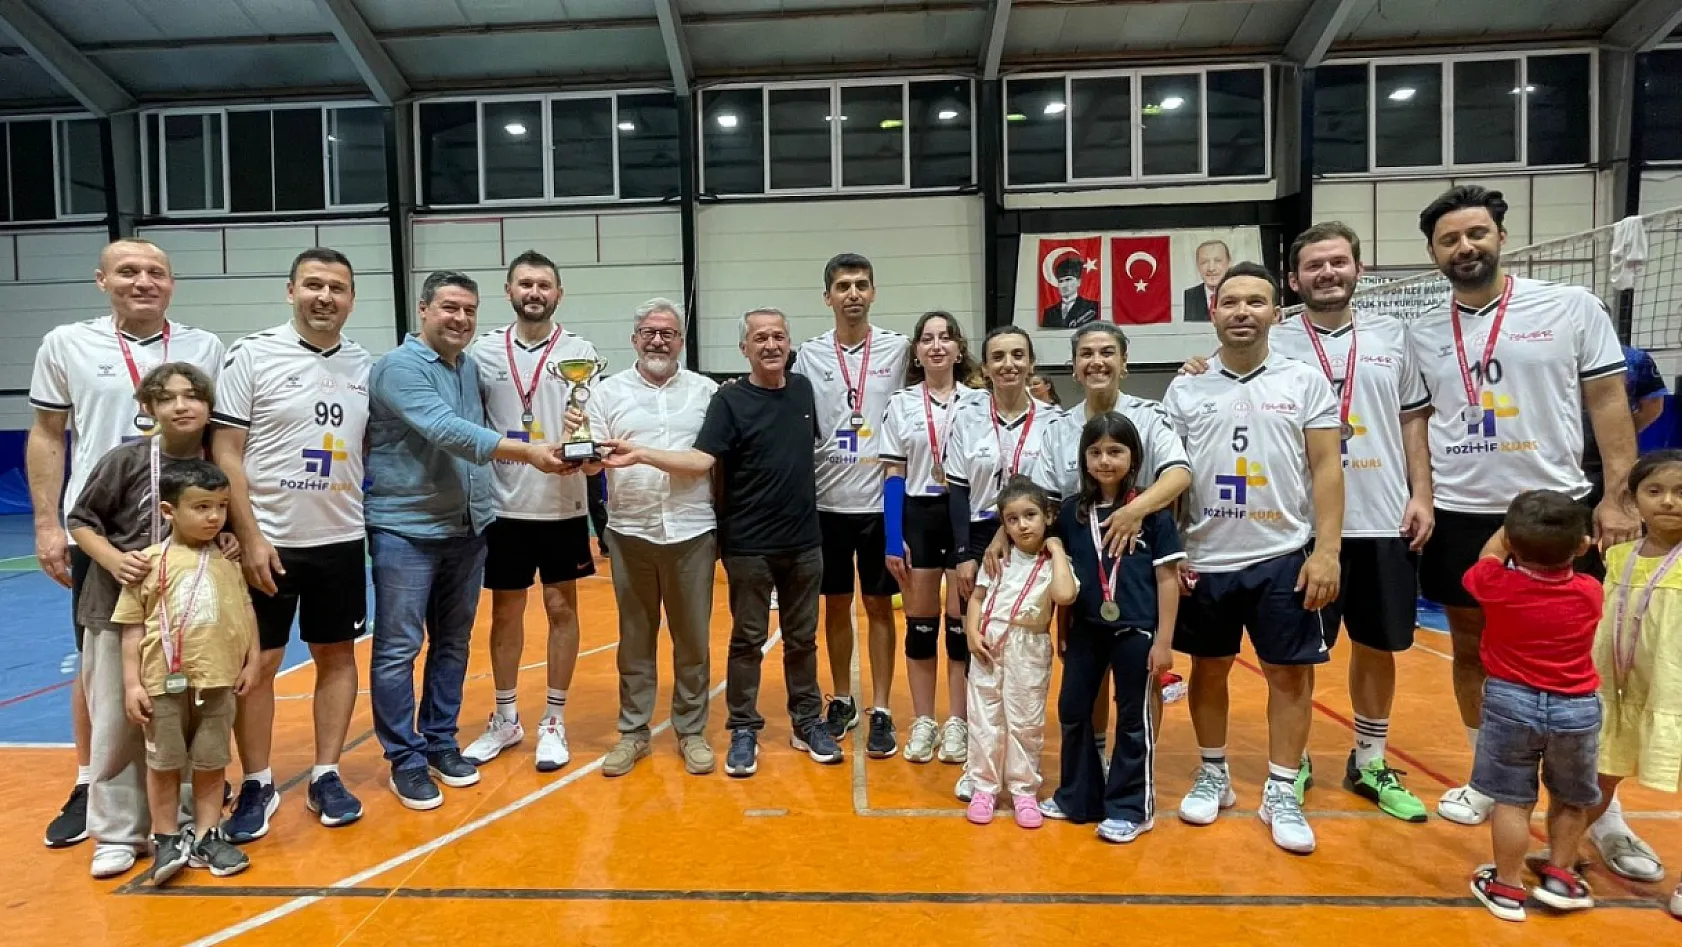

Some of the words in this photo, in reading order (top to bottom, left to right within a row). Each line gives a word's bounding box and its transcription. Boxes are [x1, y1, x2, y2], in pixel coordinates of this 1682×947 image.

[1469, 358, 1503, 386] 10
[314, 401, 344, 428] 99
[1231, 425, 1249, 453] 5
[1501, 441, 1538, 452] KURS
[1352, 459, 1382, 469] KURS
